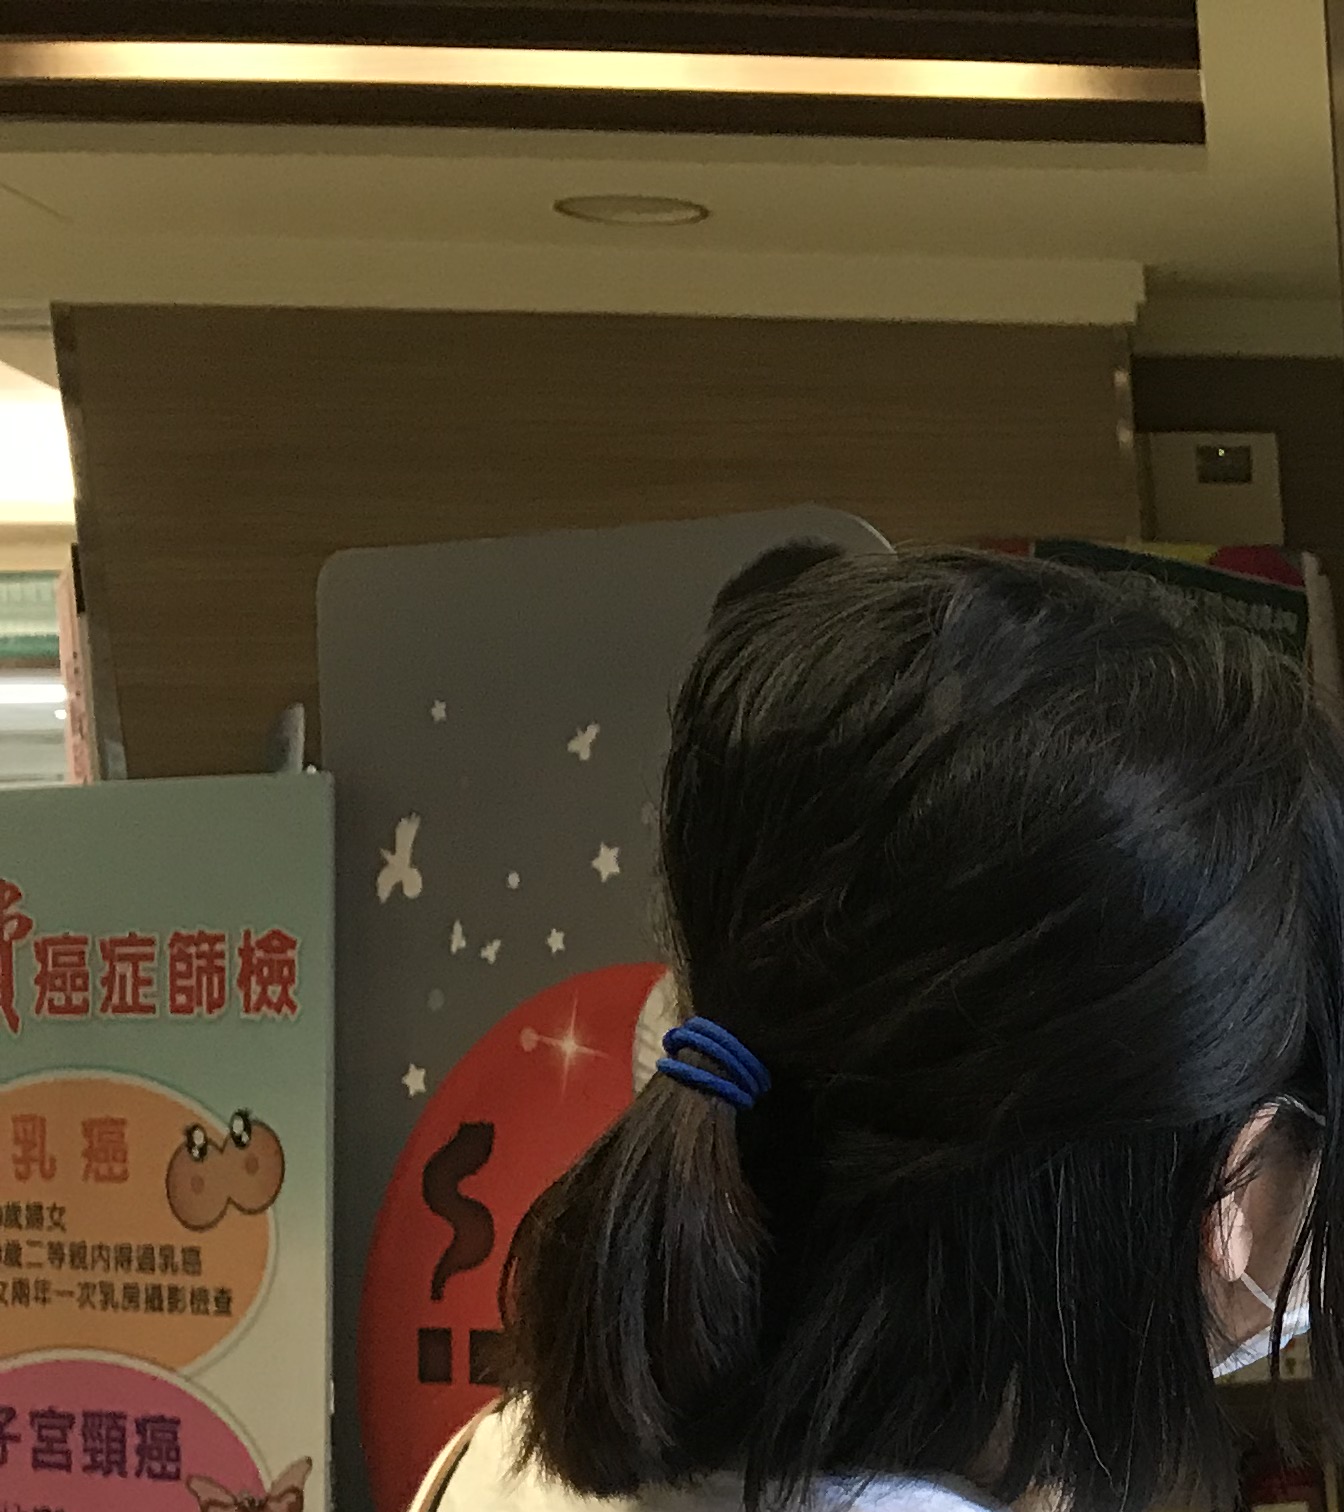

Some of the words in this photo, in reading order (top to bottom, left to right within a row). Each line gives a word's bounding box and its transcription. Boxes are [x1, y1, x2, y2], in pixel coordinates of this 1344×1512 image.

[34, 928, 298, 1015] 癌症篩檢
[12, 1113, 129, 1185] 乳癌
[0, 1200, 66, 1233] 歲婦女
[0, 1239, 202, 1277] 歲二等親內得過乳癌
